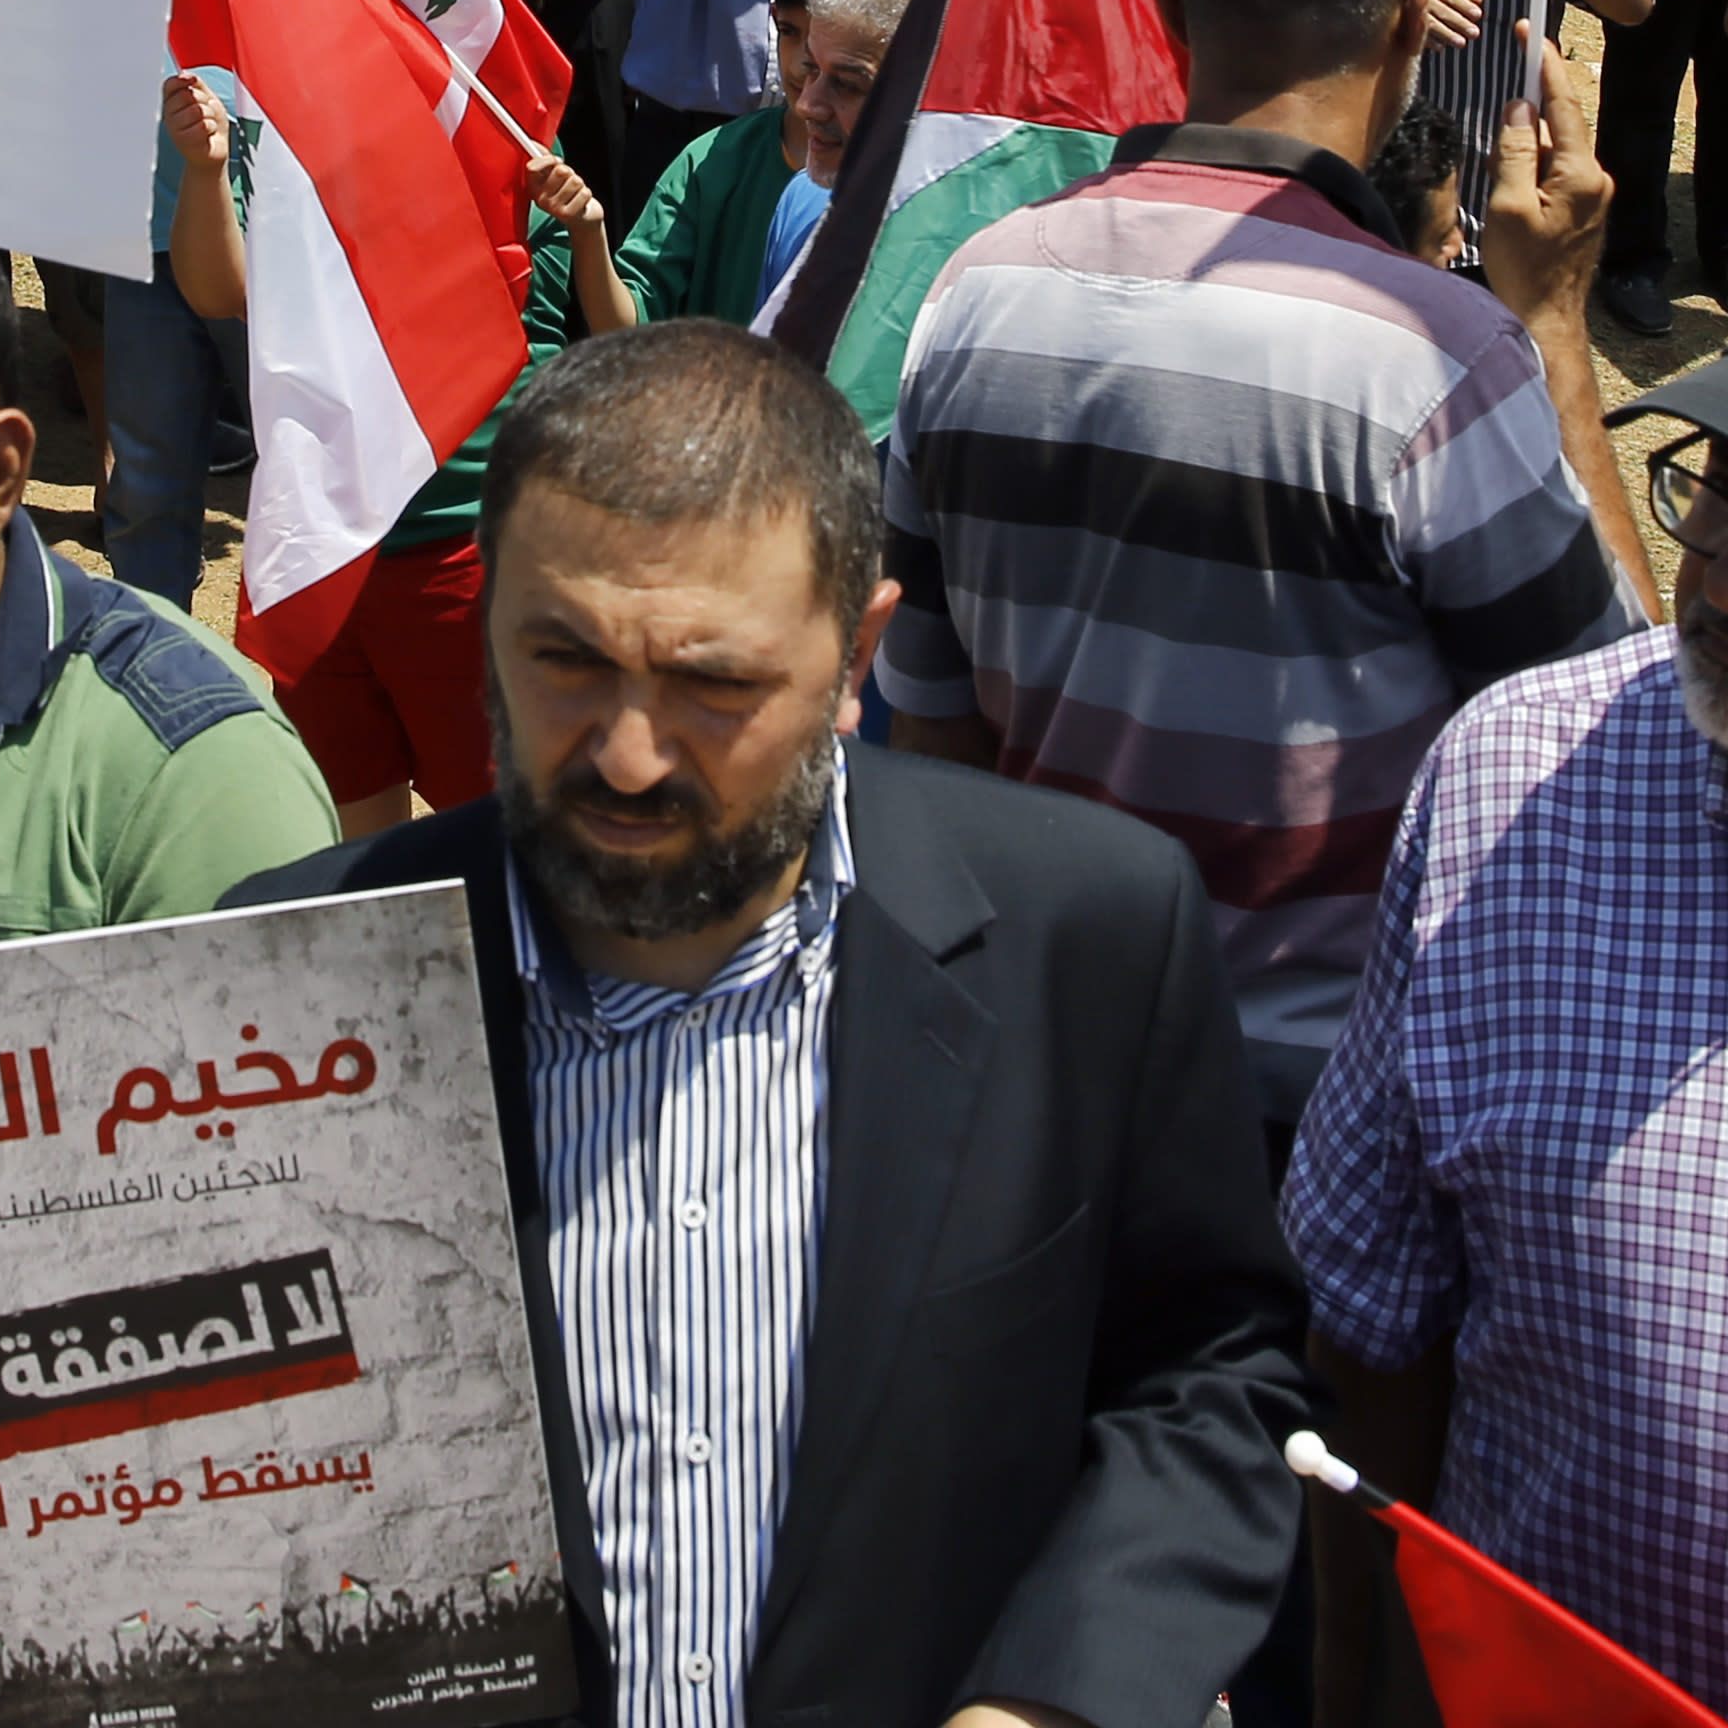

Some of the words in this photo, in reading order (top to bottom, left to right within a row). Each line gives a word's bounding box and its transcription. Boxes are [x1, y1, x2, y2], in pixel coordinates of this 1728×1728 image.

[96, 1022, 378, 1156] مخيم
[173, 1153, 302, 1195] للاجئين
[0, 1282, 275, 1400] لصفقة
[283, 1268, 343, 1348] لا
[26, 1463, 183, 1537] مؤتمر
[198, 1450, 375, 1503] يسقط
[371, 1687, 424, 1711] البحرين
